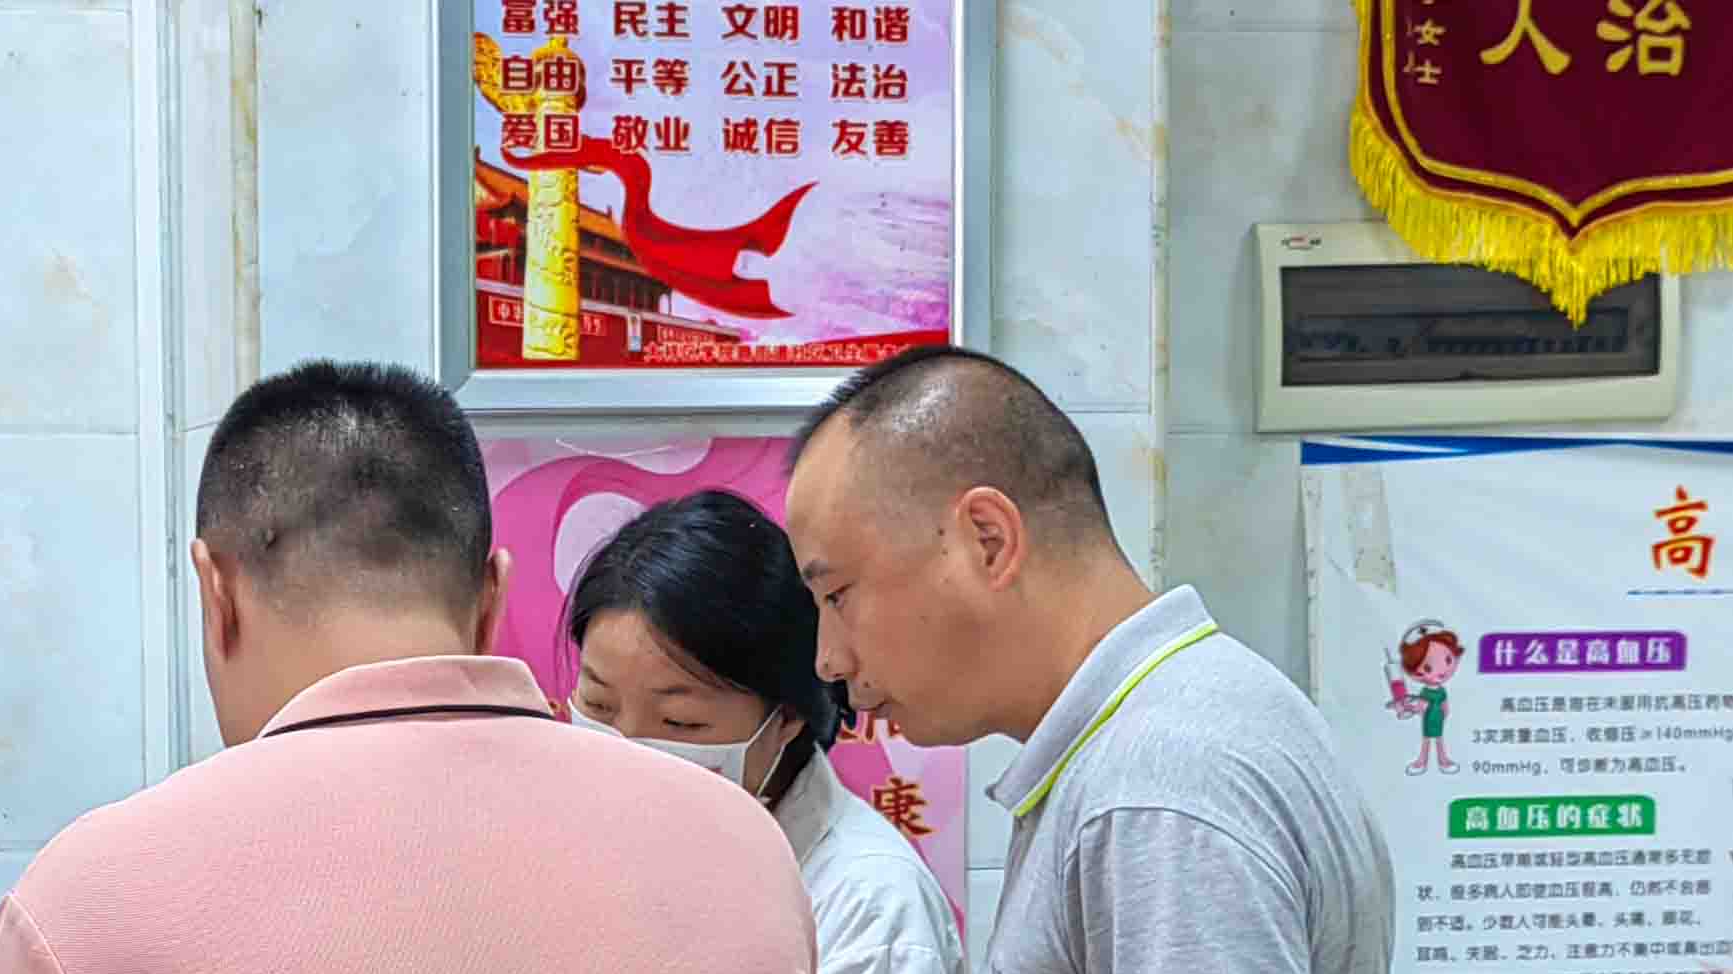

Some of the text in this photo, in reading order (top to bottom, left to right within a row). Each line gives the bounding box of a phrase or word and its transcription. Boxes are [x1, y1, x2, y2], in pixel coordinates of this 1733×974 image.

[501, 0, 909, 42] 富强 民主 文明 和谐
[1480, 0, 1571, 74] 人
[1414, 0, 1447, 86] 女士
[502, 56, 908, 99] 自由 平等 公正 法治
[502, 114, 909, 155] 爱国 敬业 诚信 友善
[1652, 486, 1715, 579] 高
[1494, 638, 1673, 667] 什么是高血压
[873, 776, 932, 834] 康
[1466, 804, 1643, 831] 高血压的症状
